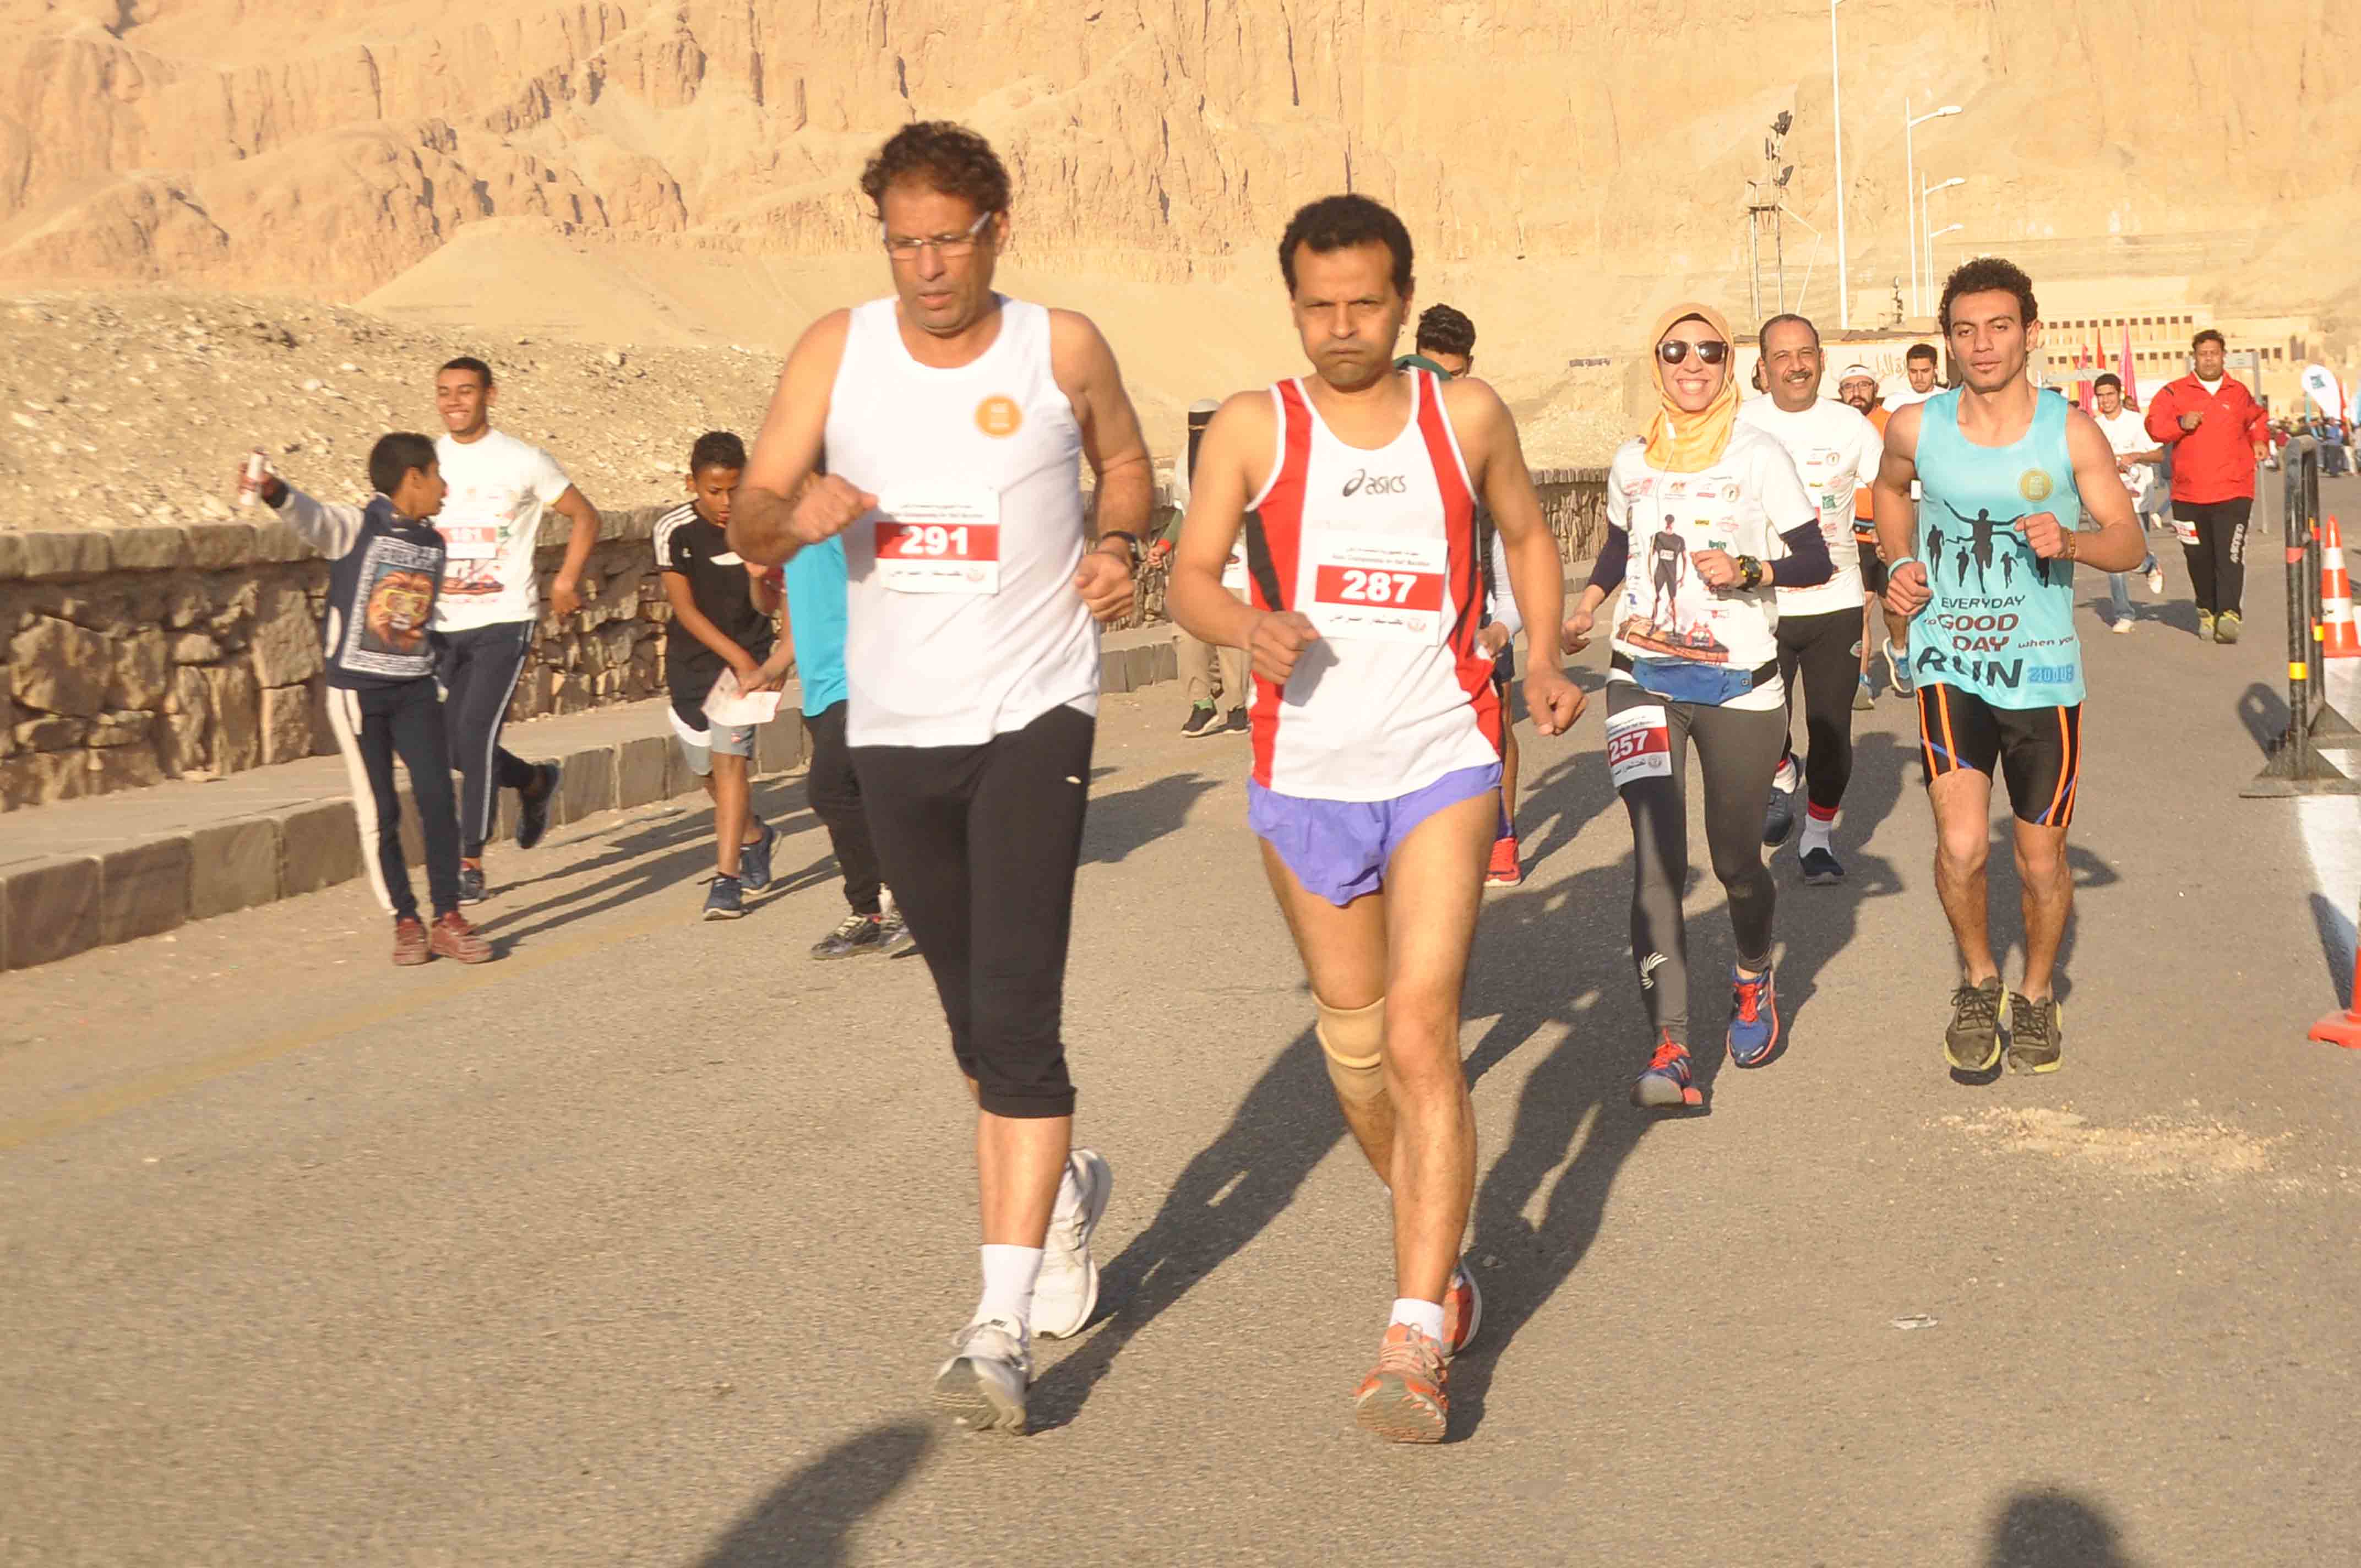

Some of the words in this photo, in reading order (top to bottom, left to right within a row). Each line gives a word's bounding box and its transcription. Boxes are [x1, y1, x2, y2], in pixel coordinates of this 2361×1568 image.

[899, 525, 968, 556] 291
[1340, 569, 1418, 603] 287
[1941, 595, 2026, 609] EVERYDAY
[1938, 613, 2019, 631] GOOD
[1952, 635, 2010, 652] DAY
[2017, 639, 2054, 649] when
[1917, 646, 2024, 688] RUN
[1609, 730, 1649, 762] 257
